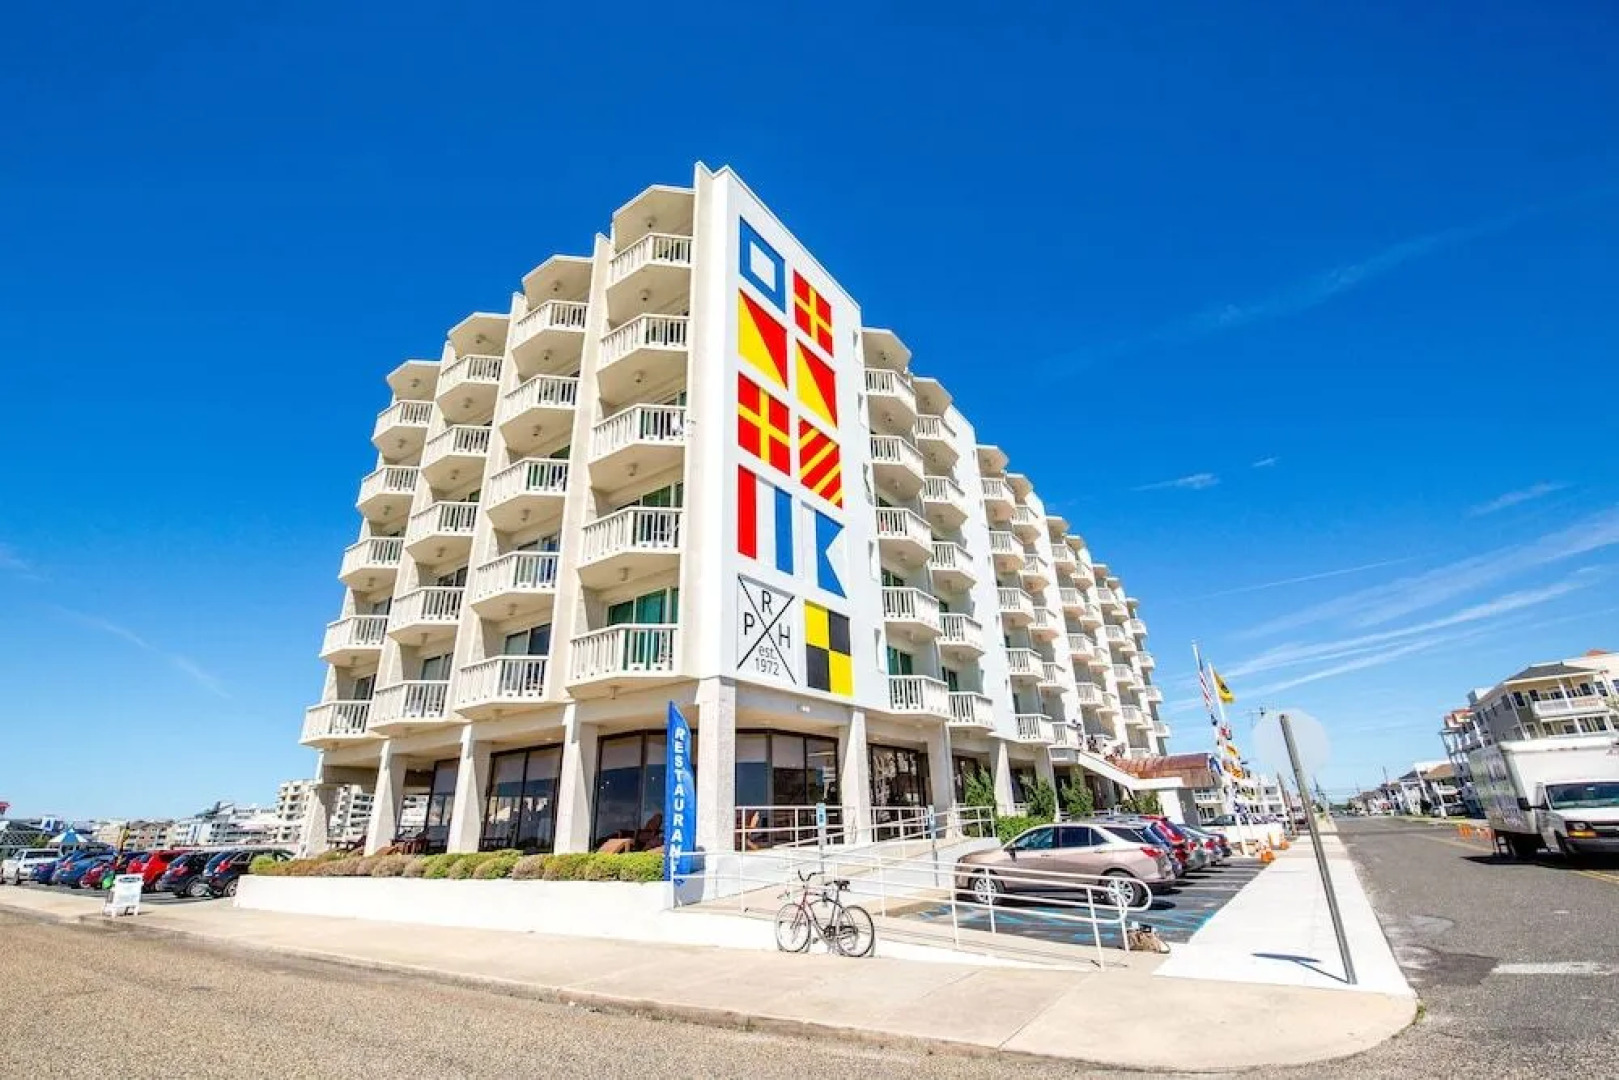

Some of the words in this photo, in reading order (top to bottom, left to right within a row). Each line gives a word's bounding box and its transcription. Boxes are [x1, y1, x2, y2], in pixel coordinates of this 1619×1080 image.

[762, 589, 773, 615] R
[744, 611, 755, 636] P
[778, 622, 791, 650] H
[755, 657, 780, 677] 1972
